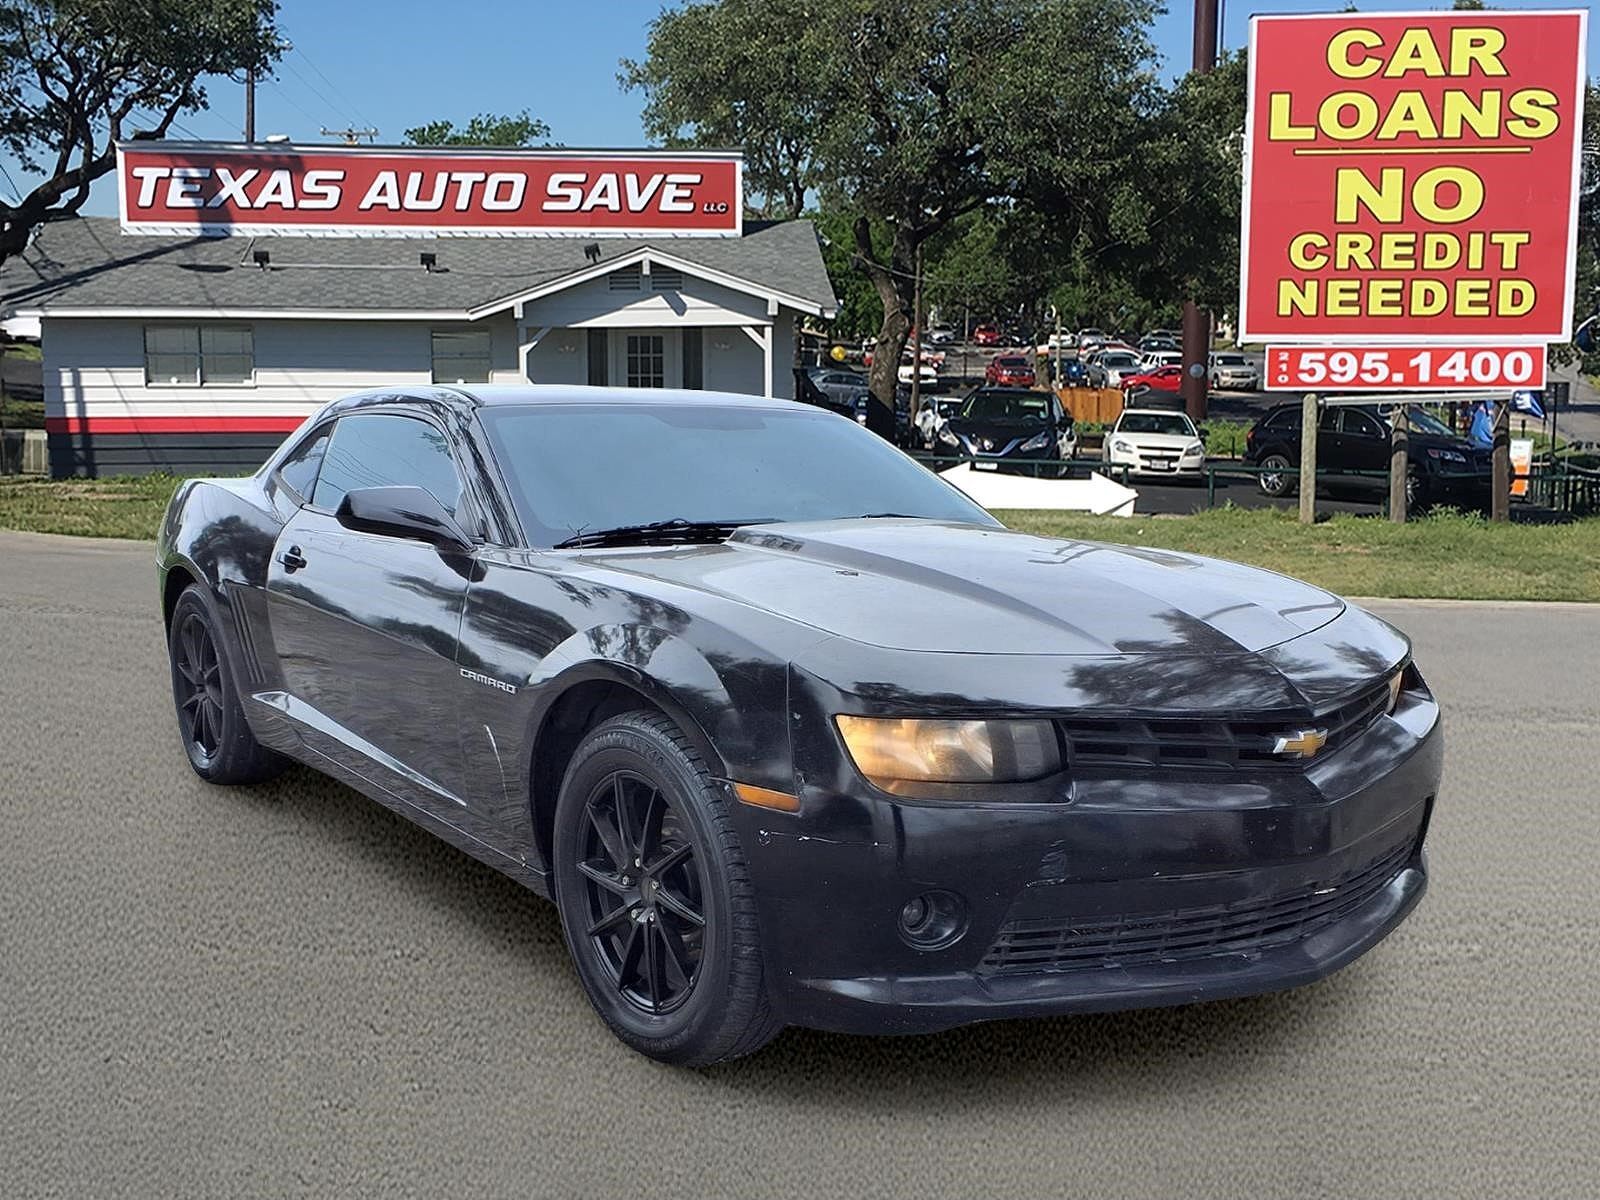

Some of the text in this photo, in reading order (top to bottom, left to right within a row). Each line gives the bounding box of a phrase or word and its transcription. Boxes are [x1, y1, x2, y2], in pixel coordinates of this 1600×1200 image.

[1326, 27, 1509, 78] CAR
[1268, 88, 1560, 141] LOANS
[131, 167, 728, 213] TEXAS AUTO SAVE LLC
[1334, 166, 1485, 224] NO
[1288, 231, 1531, 271] CREDIT
[1277, 278, 1537, 317] NEEDED
[1296, 351, 1533, 384] 595.1400
[460, 668, 517, 694] CAMARO
